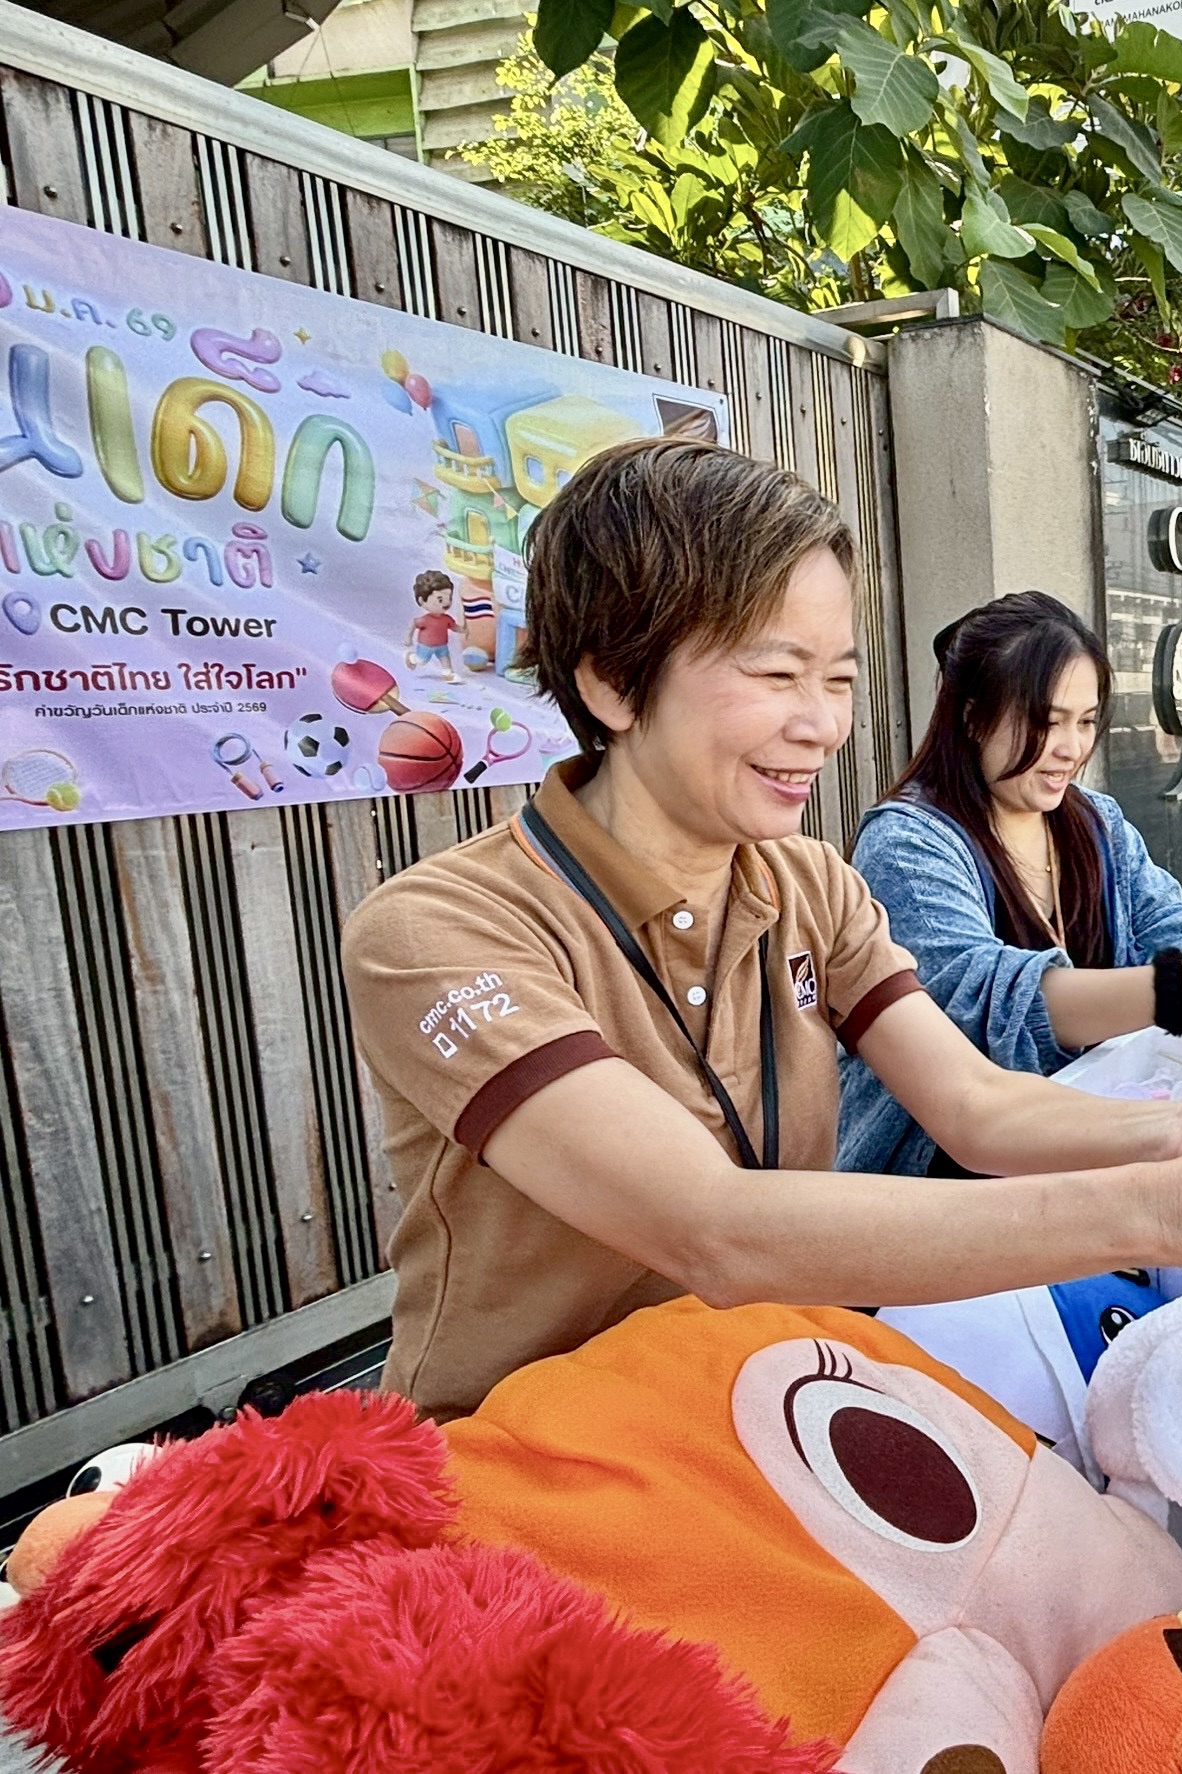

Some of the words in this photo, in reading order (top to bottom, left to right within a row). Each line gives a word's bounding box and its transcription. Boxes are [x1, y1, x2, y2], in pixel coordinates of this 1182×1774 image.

[126, 307, 177, 341] 69
[50, 603, 149, 636] CMC
[160, 608, 278, 638] Tower
[191, 701, 234, 715] ประจำปี
[237, 701, 268, 714] 2569
[419, 972, 503, 1034] cmc.co.th
[449, 992, 521, 1039] 1172
